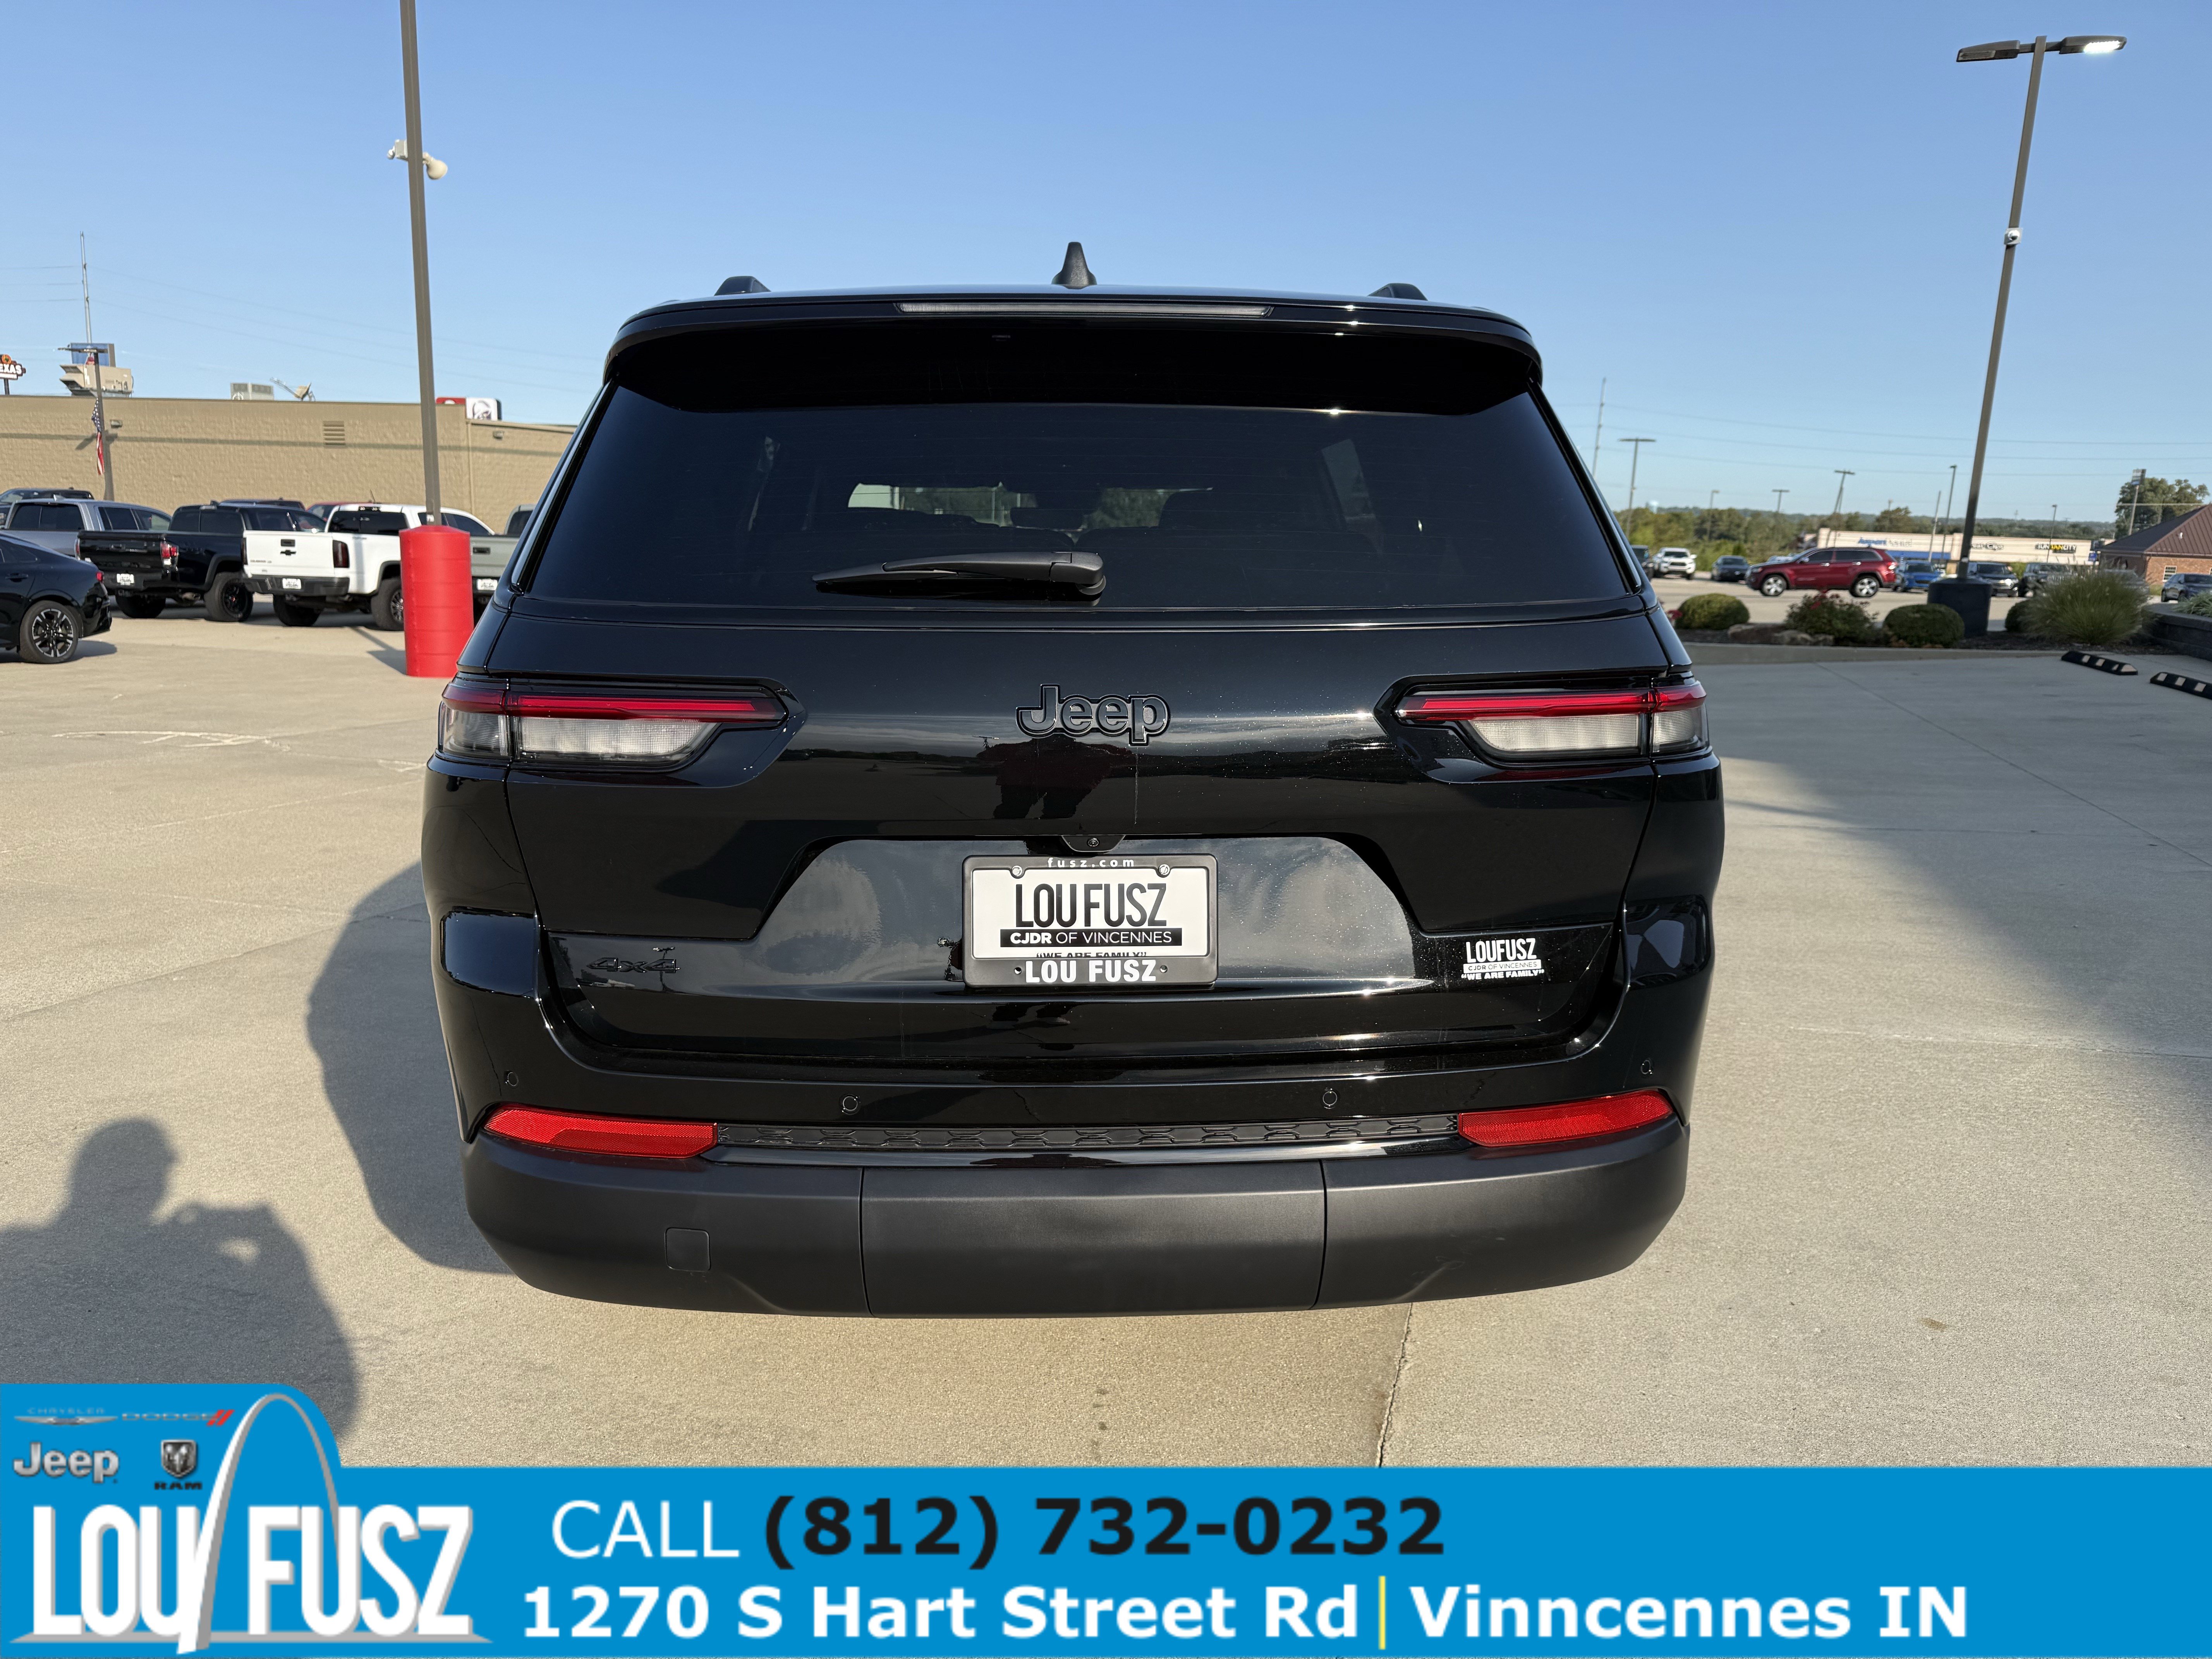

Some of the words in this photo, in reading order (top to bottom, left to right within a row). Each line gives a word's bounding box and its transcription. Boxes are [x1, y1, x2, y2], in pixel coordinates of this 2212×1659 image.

[1016, 684, 1171, 746] Jeep
[1048, 857, 1135, 867] fusz.com
[1015, 883, 1077, 928] LOU
[1084, 883, 1167, 927] FUSZ
[1010, 932, 1052, 944] CJDR
[1056, 932, 1077, 944] OF
[1082, 931, 1172, 944] VINCENNES
[1025, 960, 1077, 983] LOU
[1089, 959, 1156, 982] FUSZ
